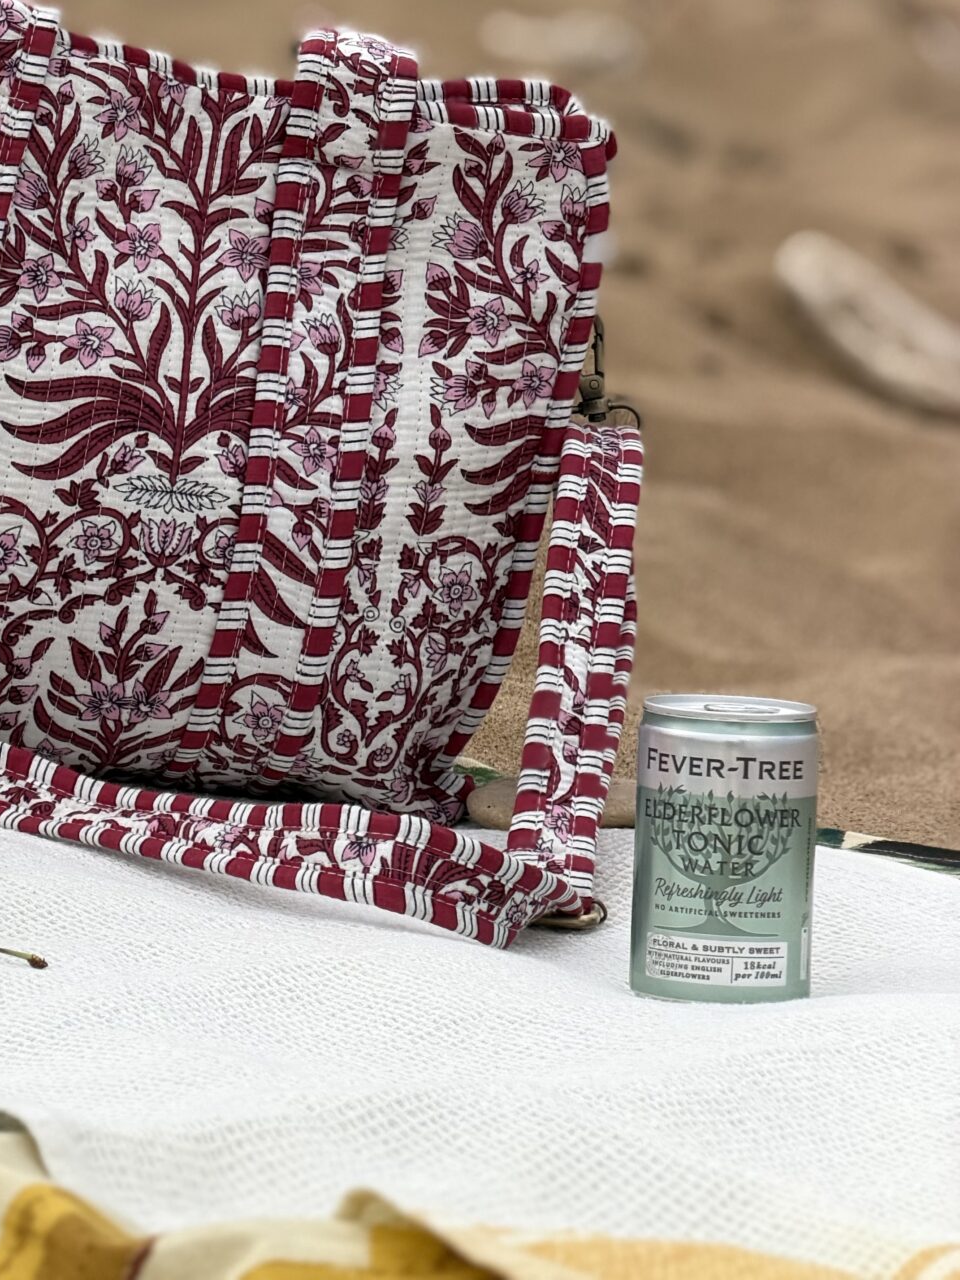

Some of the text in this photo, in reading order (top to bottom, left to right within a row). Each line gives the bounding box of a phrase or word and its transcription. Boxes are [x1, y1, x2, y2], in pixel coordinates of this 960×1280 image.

[645, 798, 802, 828] ELDERFLOWER
[673, 830, 764, 856] TONIC
[678, 854, 756, 876] WATER
[655, 877, 783, 908] Refreshingly Light
[655, 903, 781, 919] NO ARTIFICIAL SWEETENERS
[653, 938, 688, 951] FLORAL
[702, 944, 745, 954] SUBTLY
[748, 947, 781, 955] SWEET
[691, 965, 722, 973] ENGLISH
[694, 956, 730, 965] FLAVOURS
